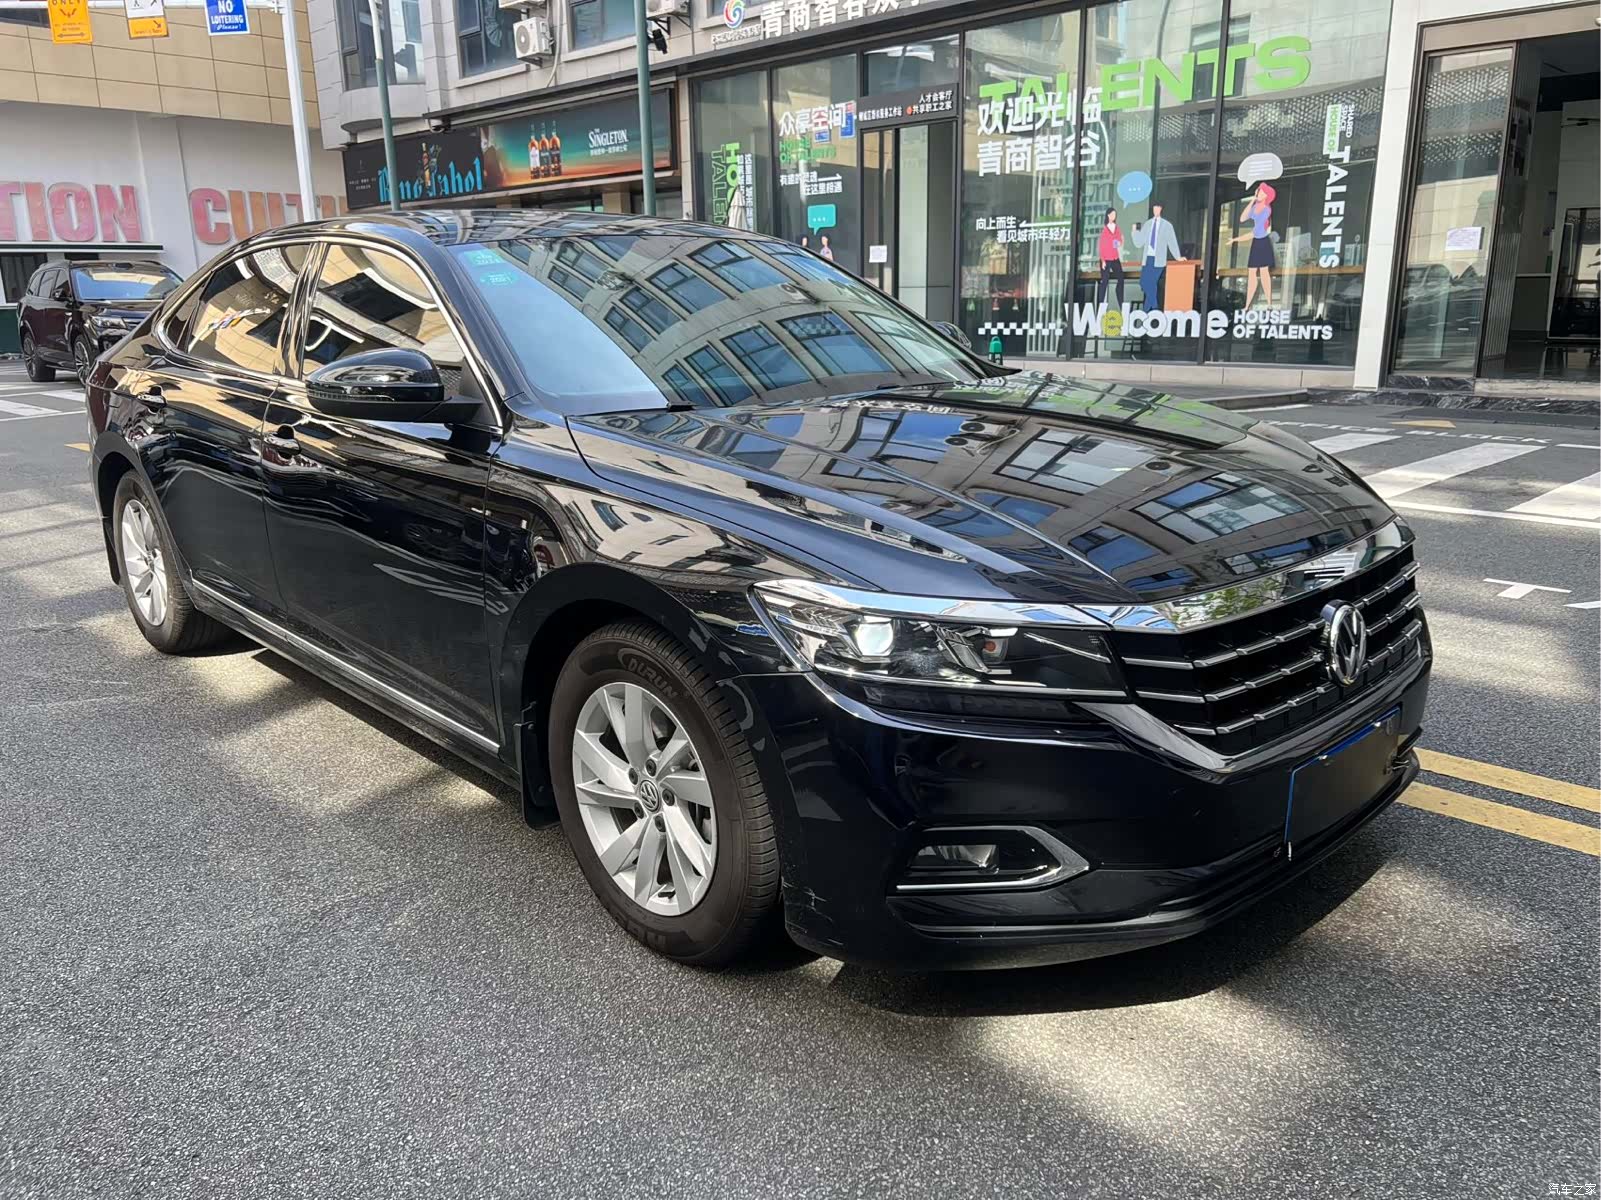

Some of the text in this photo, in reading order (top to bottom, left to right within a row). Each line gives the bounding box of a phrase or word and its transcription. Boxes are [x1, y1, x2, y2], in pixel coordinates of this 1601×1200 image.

[218, 0, 234, 13] NO
[211, 15, 244, 24] LOITERING
[979, 36, 1313, 119] TALENTS
[977, 86, 1103, 136] 欢迎光临
[588, 129, 630, 148] SINGLETON
[977, 130, 1099, 177] 青商智谷
[1319, 145, 1351, 268] TALENTS
[976, 216, 1017, 231] 向上而生
[996, 227, 1071, 243] 看见城市年轻力
[1065, 302, 1229, 338] Welcome
[1233, 309, 1291, 325] HOUSE
[1233, 323, 1333, 340] OF TALENTS
